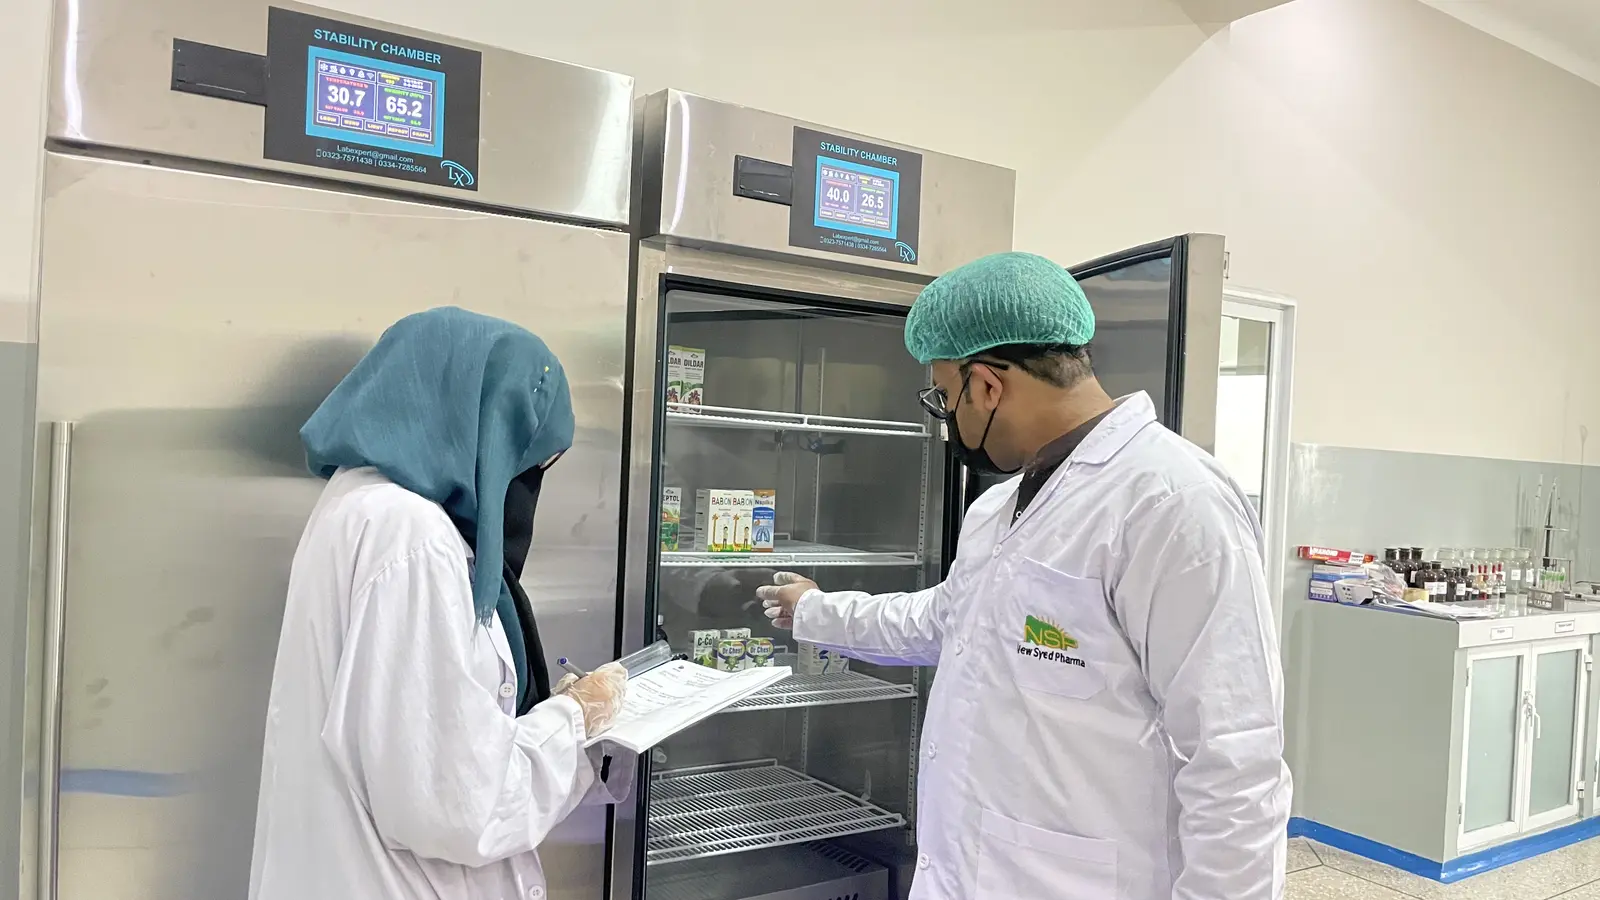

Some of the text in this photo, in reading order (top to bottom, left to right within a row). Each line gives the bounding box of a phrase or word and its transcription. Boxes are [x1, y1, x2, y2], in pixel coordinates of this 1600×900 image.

[314, 29, 441, 65] STABILITY CHAMBER
[328, 85, 366, 107] 30.7
[386, 96, 422, 118] 65.2
[322, 151, 373, 165] 0323-7571438
[378, 161, 427, 174] 0334-7285564
[337, 145, 414, 163] Labexpert@gmail.com
[820, 142, 897, 166] STABILITY CHAMBER
[826, 187, 850, 203] 40.0
[861, 193, 884, 209] 26.5
[1033, 647, 1054, 661] Syed
[1055, 652, 1086, 668] Pharma
